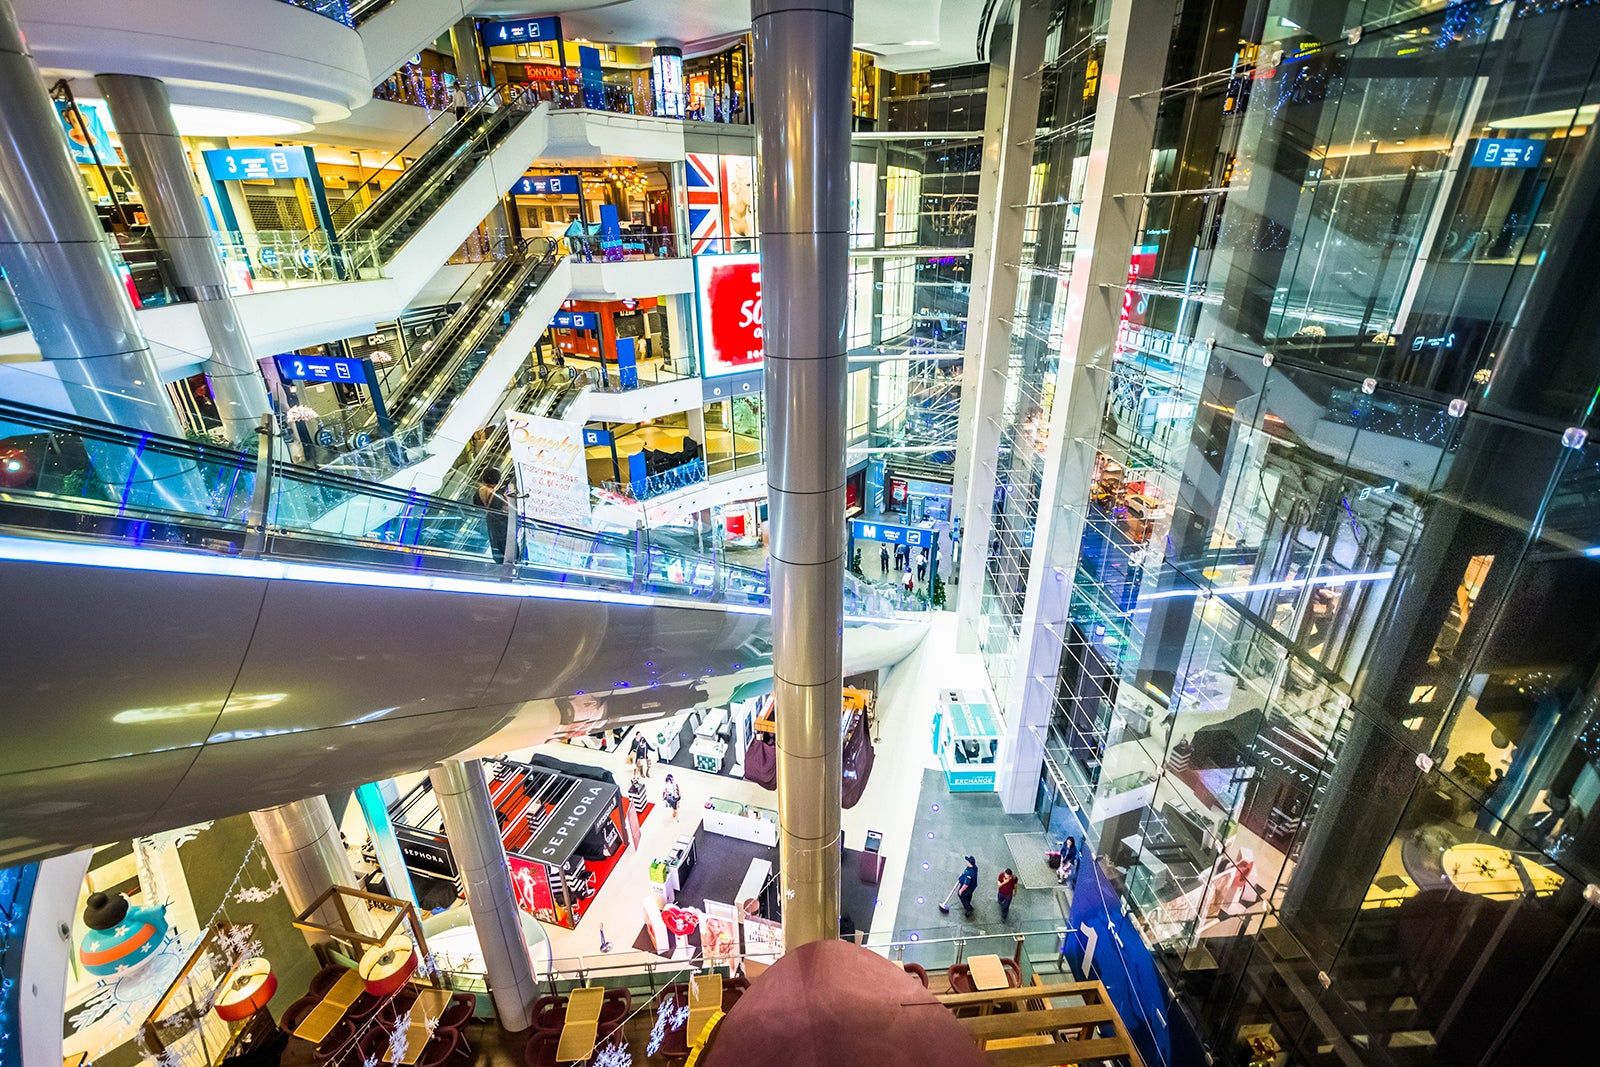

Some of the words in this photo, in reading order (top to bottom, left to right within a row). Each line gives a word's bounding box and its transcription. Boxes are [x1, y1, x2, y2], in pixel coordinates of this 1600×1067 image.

[500, 26, 507, 40] 4
[525, 65, 546, 78] TONY
[225, 155, 237, 173] 3
[523, 179, 531, 191] 3
[294, 361, 305, 376] 2
[863, 525, 876, 538] M
[542, 786, 602, 856] SEPHORA
[404, 848, 444, 863] SEPHORA
